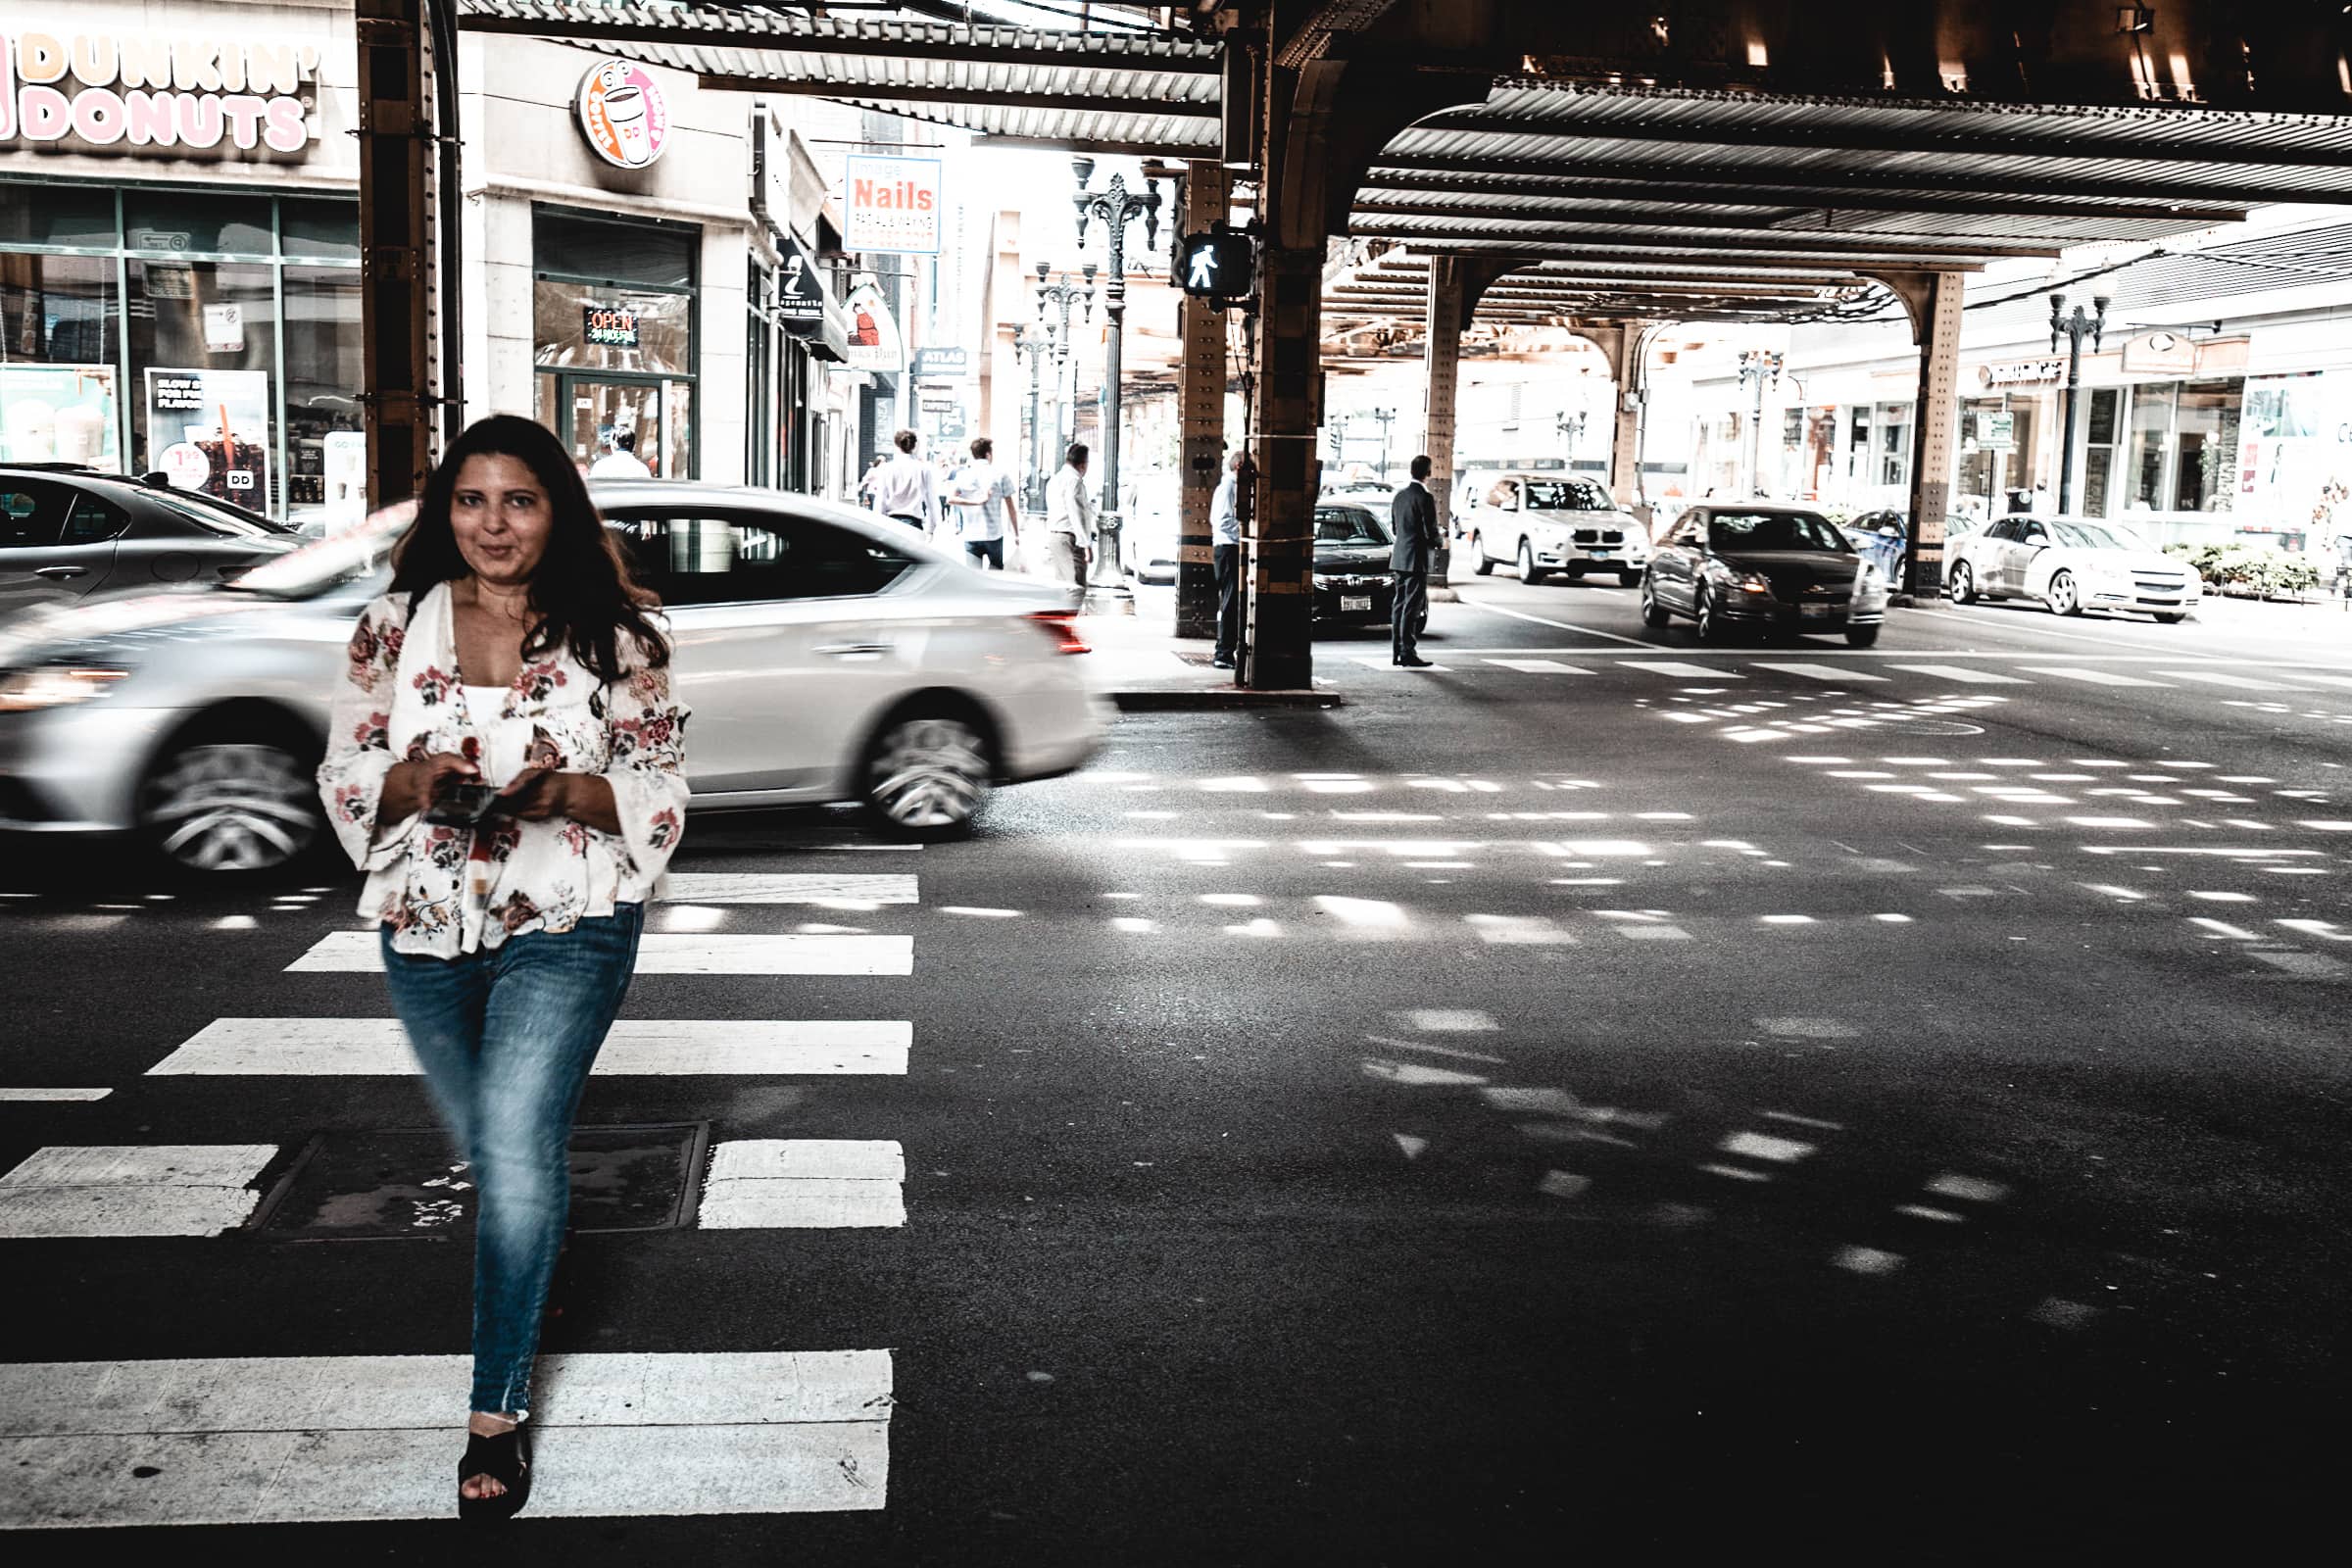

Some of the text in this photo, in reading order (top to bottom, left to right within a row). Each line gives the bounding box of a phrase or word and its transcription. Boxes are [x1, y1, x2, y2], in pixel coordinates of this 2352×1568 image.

[17, 31, 319, 93] DUNKIN'
[20, 86, 306, 151] DONUTS
[590, 91, 612, 148] COFFEE
[855, 178, 932, 211] Nails
[592, 313, 633, 330] OPEN
[922, 351, 965, 364] ATLAS
[231, 475, 250, 485] DD
